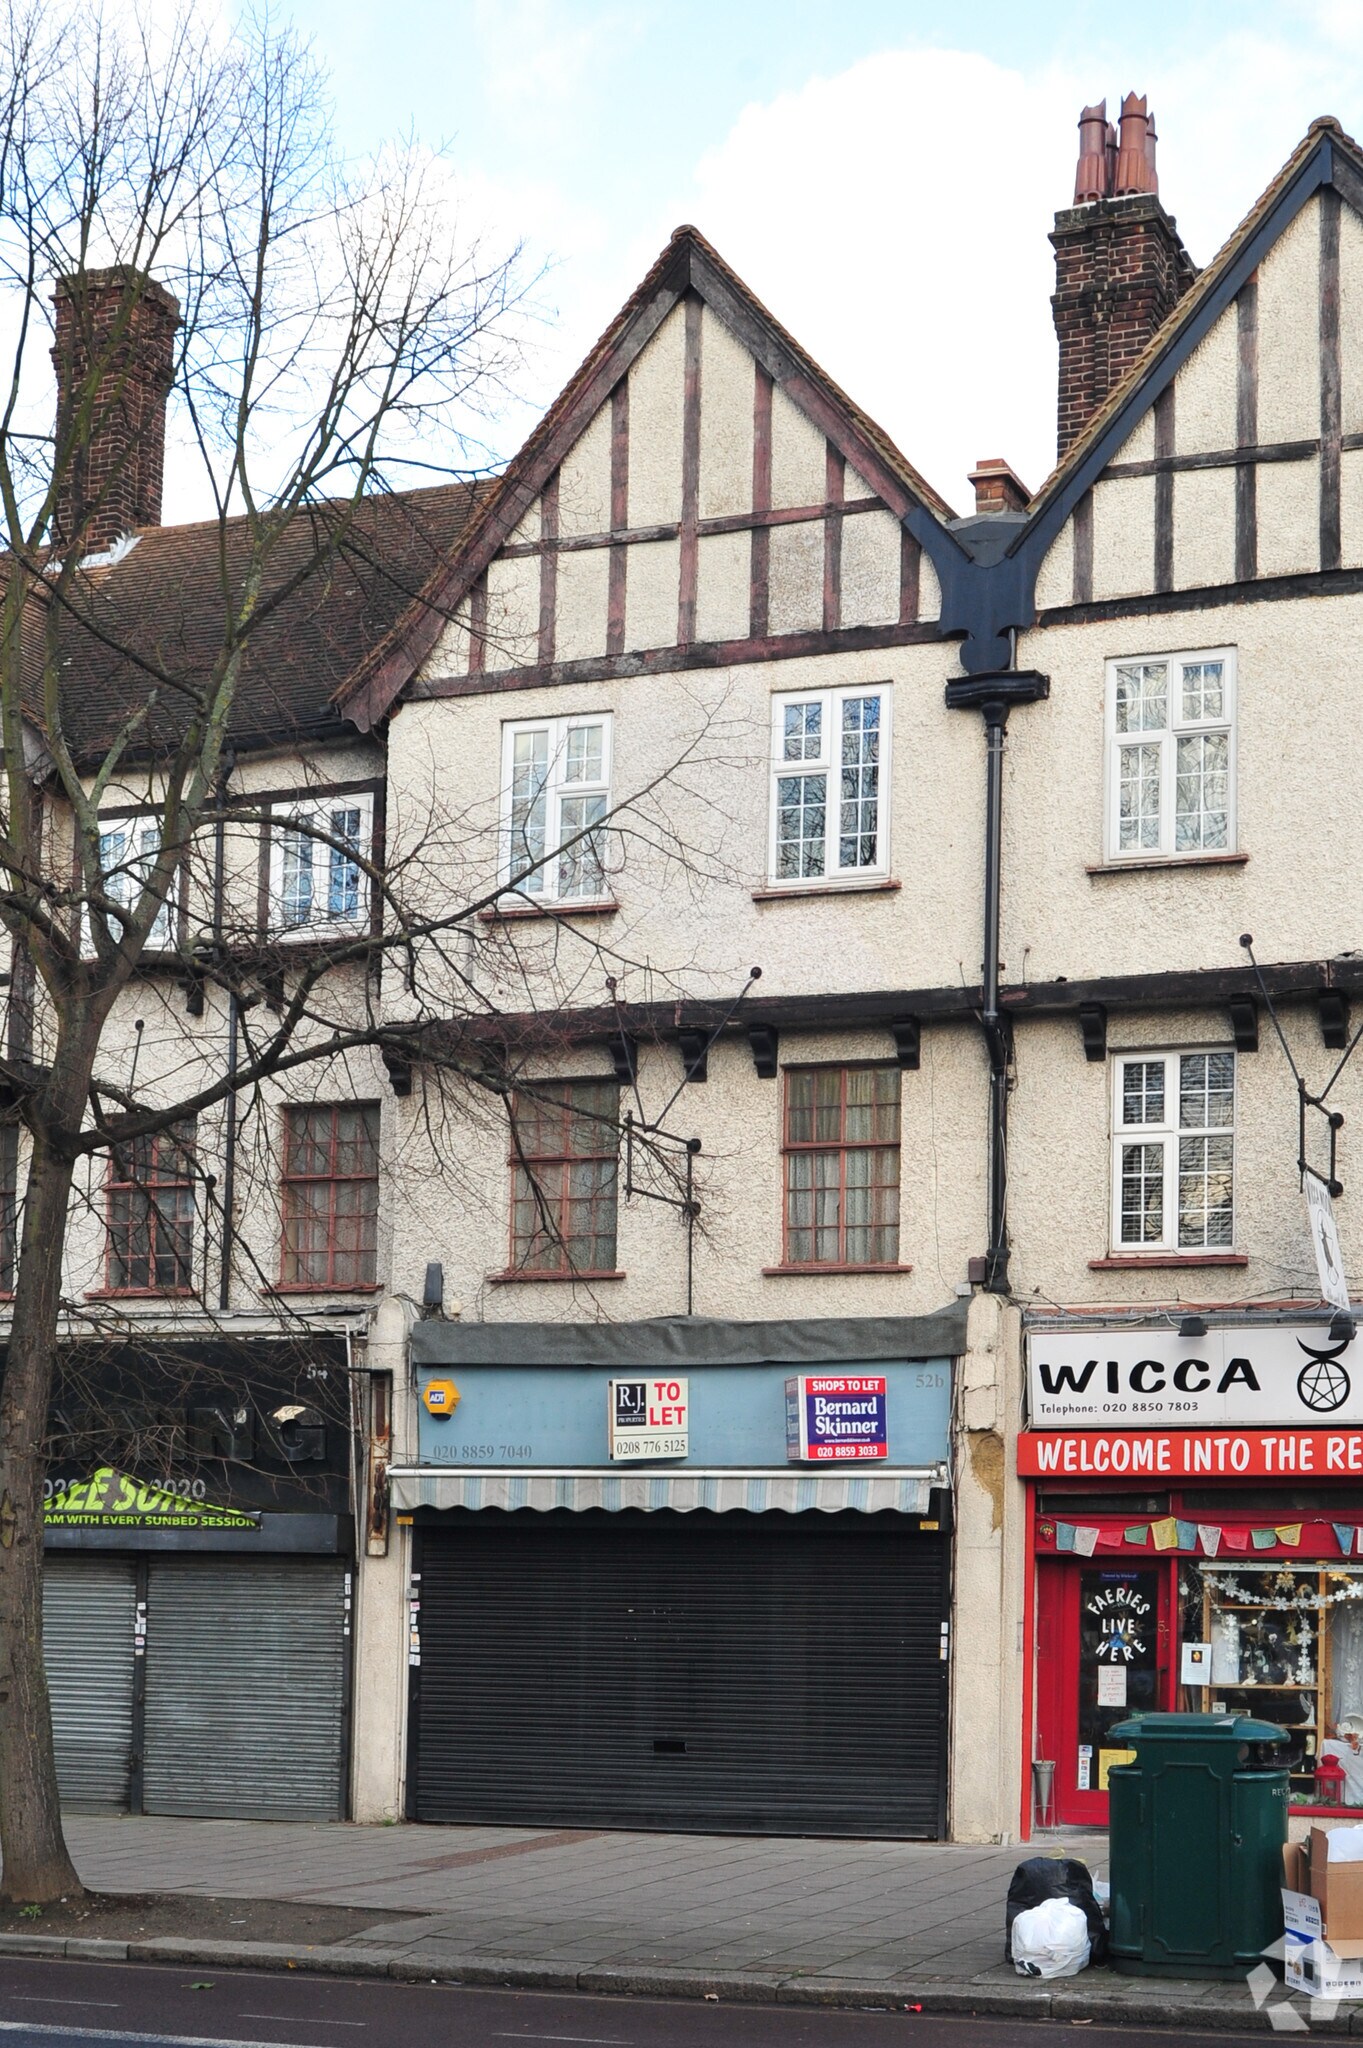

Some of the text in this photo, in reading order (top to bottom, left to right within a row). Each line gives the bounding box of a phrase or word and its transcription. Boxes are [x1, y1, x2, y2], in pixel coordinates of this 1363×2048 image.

[915, 1374, 944, 1388] 52b
[1039, 1358, 1261, 1394] WICCA
[653, 1382, 681, 1402] TO
[812, 1380, 846, 1391] SHOPS
[847, 1380, 860, 1391] TO
[862, 1380, 880, 1391] LET
[429, 1392, 445, 1403] ADT
[618, 1385, 645, 1414] R.J.
[814, 1396, 878, 1415] Bernard
[650, 1406, 686, 1426] LET
[1040, 1401, 1199, 1415] Telephone: 020 8850 7803
[815, 1416, 879, 1436] Skinner
[433, 1445, 532, 1459] 020 8859 7040
[616, 1439, 686, 1454] 0208 776 5125
[817, 1446, 878, 1457] 020 8859 3033
[1037, 1437, 1171, 1473] WELCOME
[1184, 1437, 1250, 1472] INTO
[1261, 1436, 1313, 1471] THE
[67, 1514, 99, 1524] WITH
[102, 1515, 142, 1525] EVERY
[145, 1516, 198, 1526] SUNBED
[1087, 1587, 1150, 1615] FAERIES
[1102, 1617, 1135, 1634] LIVE
[1095, 1640, 1146, 1661] HERE
